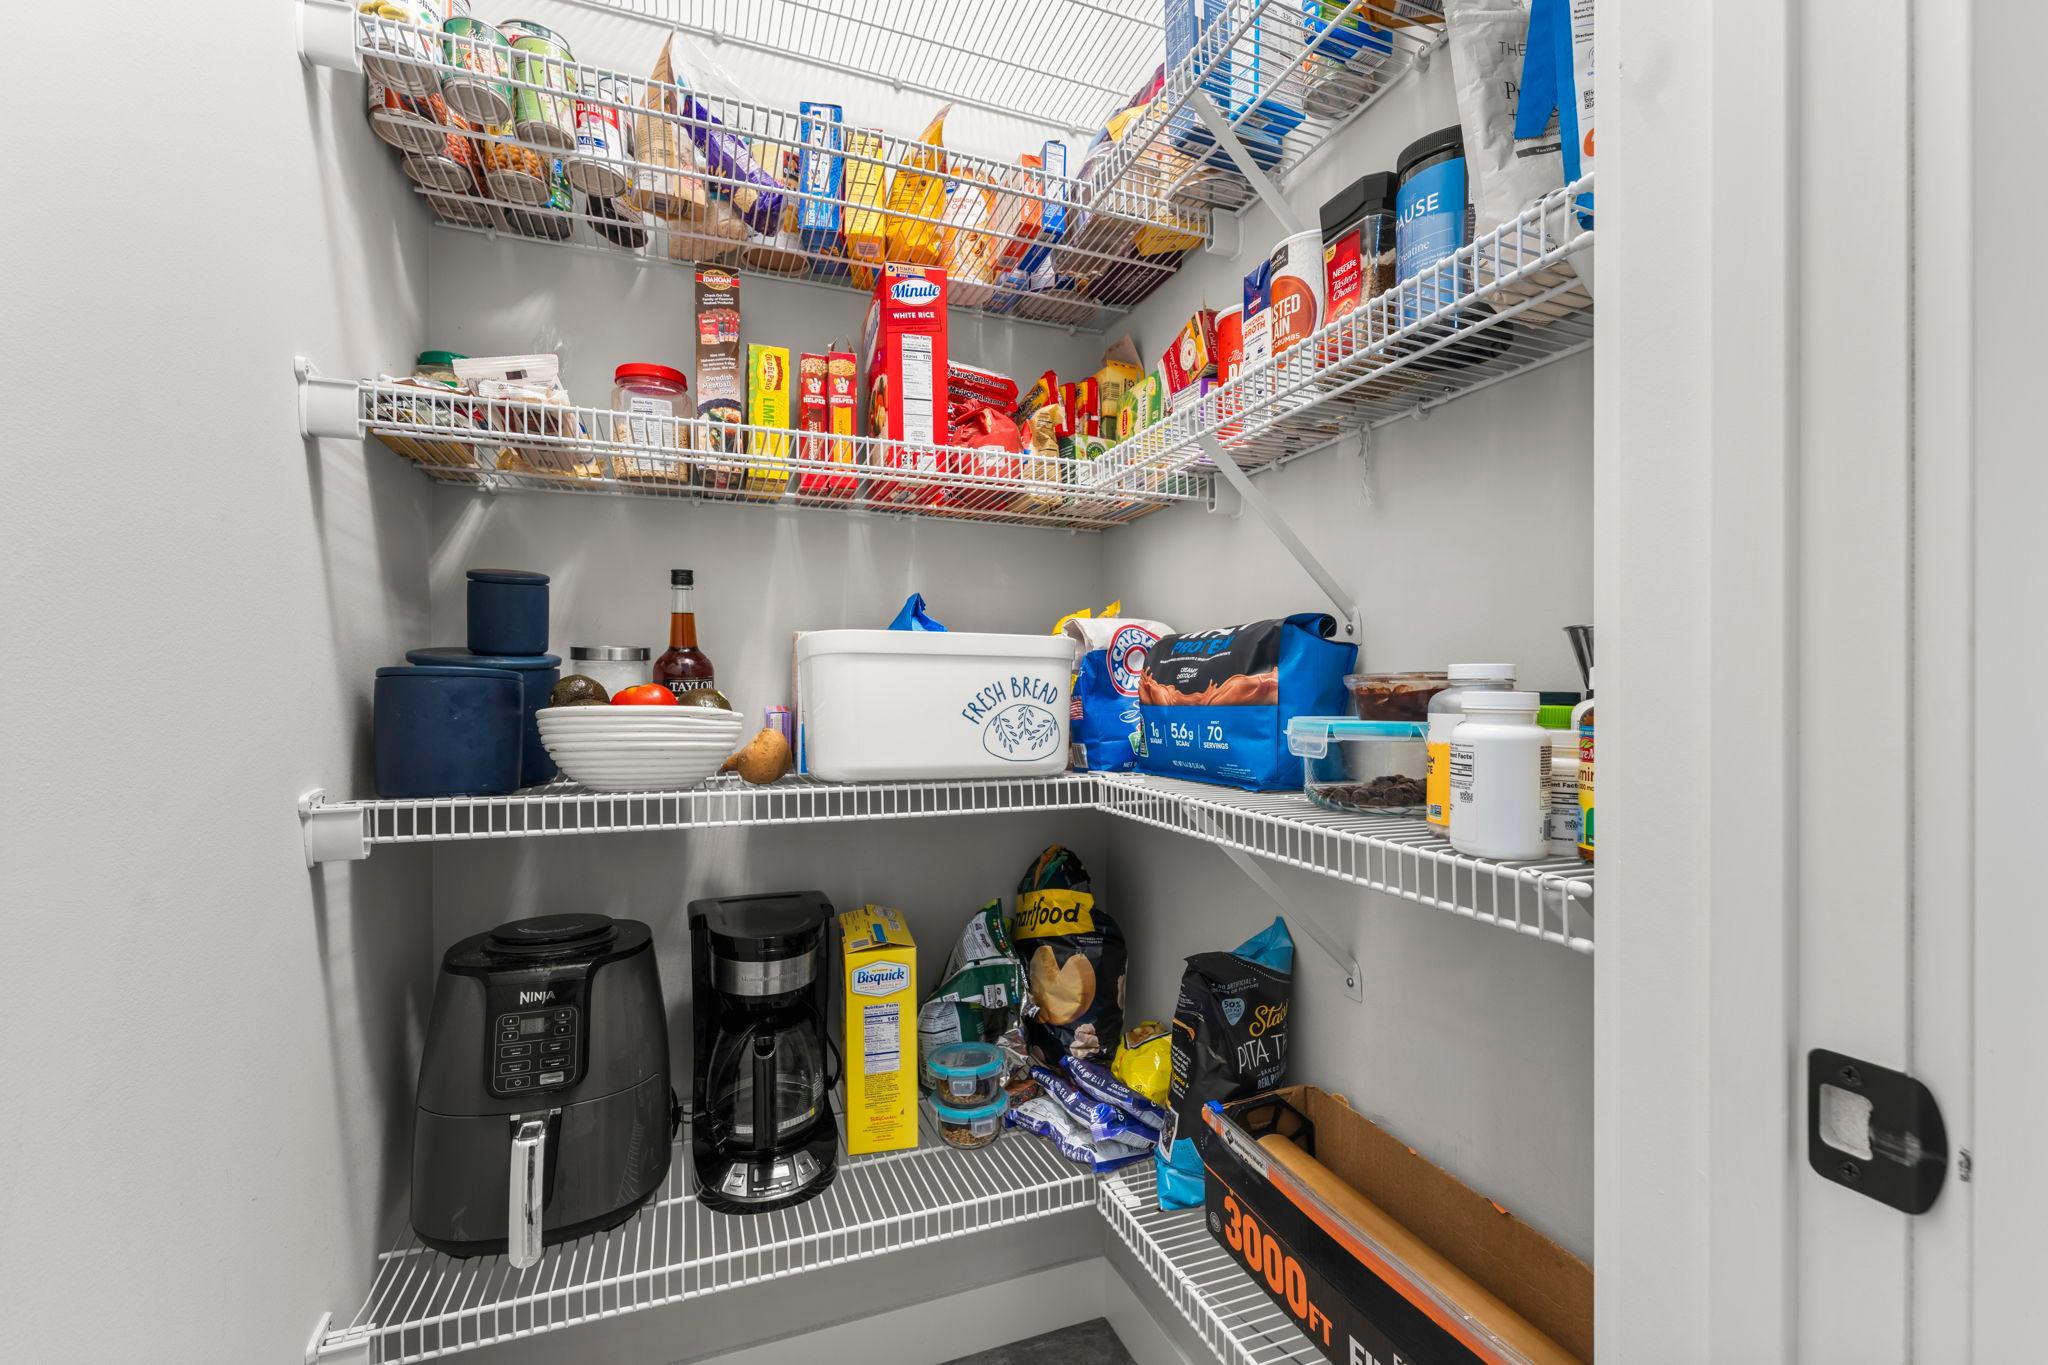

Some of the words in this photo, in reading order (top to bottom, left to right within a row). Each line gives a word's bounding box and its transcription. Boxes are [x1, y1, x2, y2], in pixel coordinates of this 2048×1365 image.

[1498, 41, 1527, 57] THE
[703, 275, 732, 284] IDAHOAN
[892, 283, 940, 299] Minute
[1333, 282, 1358, 302] Choice
[892, 312, 917, 320] WHITE
[917, 311, 936, 319] RICE
[1275, 332, 1301, 348] CRUMBS
[705, 375, 734, 383] Swedish
[949, 369, 984, 383] Maruchan
[948, 386, 983, 400] Maruchan
[803, 397, 826, 405] HELPER
[830, 397, 854, 405] HELPER
[762, 397, 775, 427] LIME
[669, 680, 713, 692] TAYLOR
[961, 680, 1007, 725] FRESH
[1010, 676, 1058, 705] BREAD
[1207, 726, 1223, 741] 70
[1203, 741, 1229, 750] SERVINGS
[1457, 752, 1473, 760] Facts
[857, 968, 905, 985] Bisquick
[519, 991, 556, 1005] NINJA
[1224, 1000, 1242, 1009] 50%
[1237, 1039, 1270, 1074] PITA
[1224, 1195, 1308, 1320] 3000
